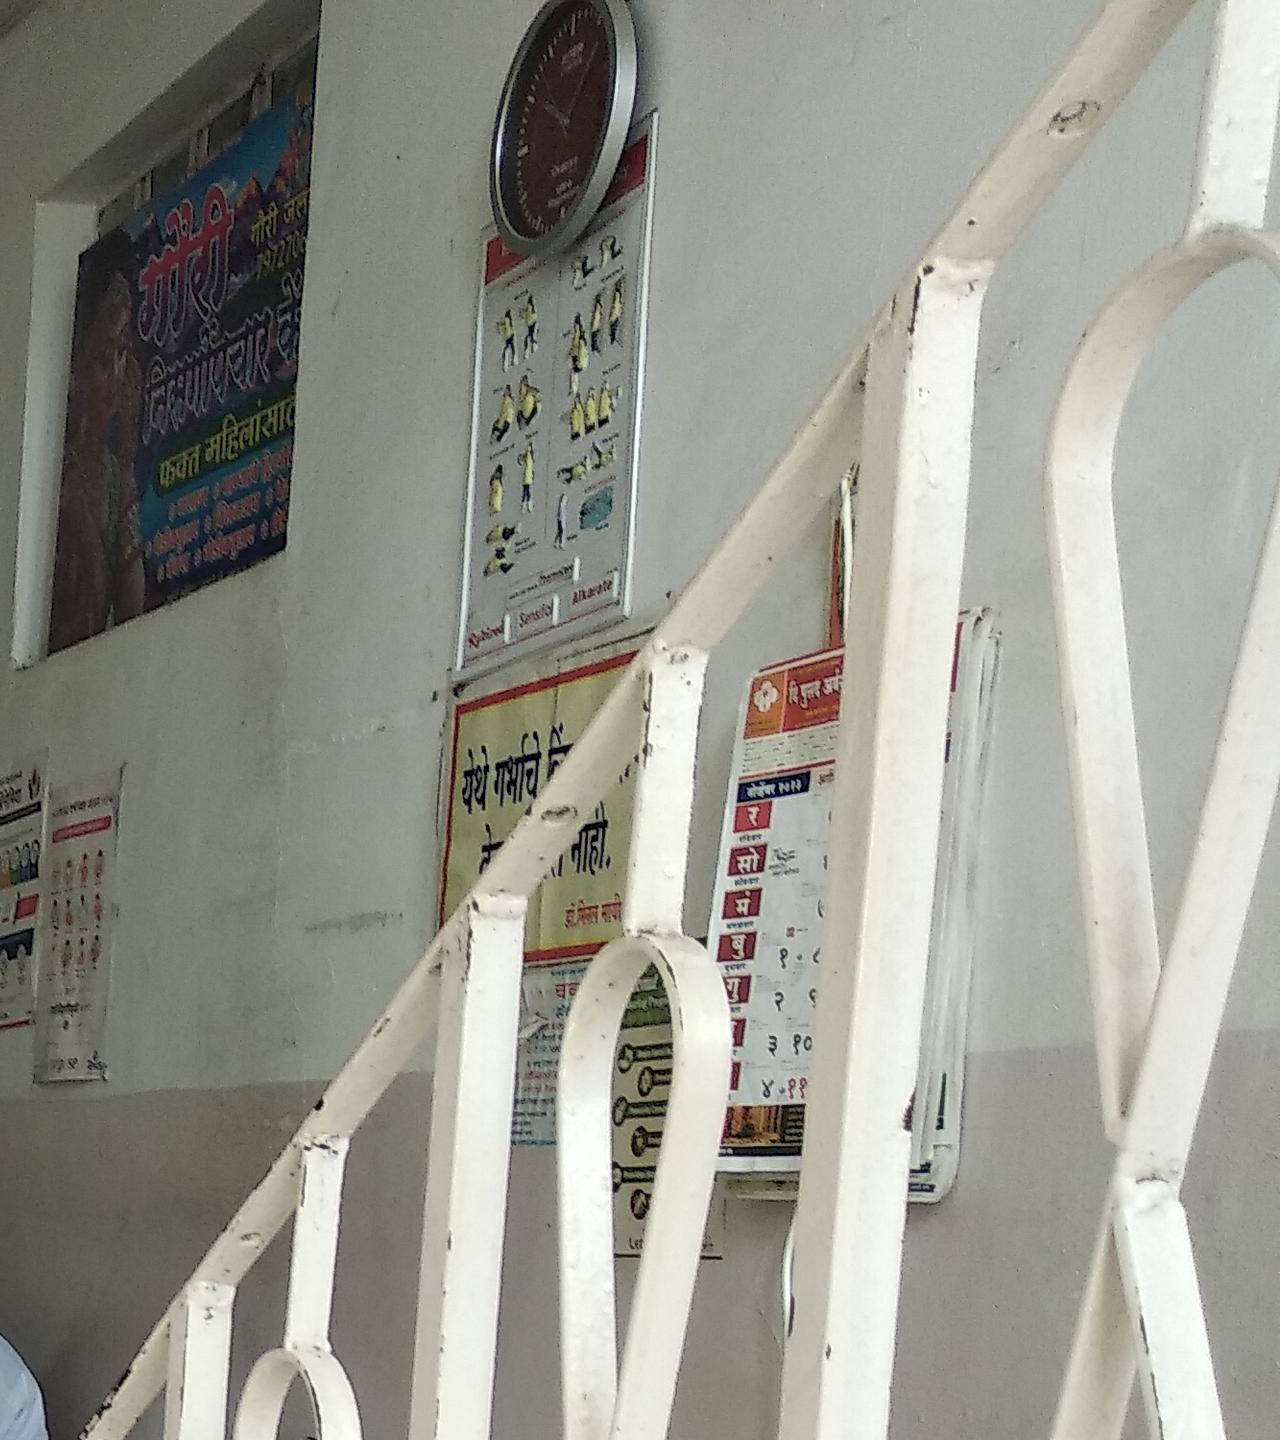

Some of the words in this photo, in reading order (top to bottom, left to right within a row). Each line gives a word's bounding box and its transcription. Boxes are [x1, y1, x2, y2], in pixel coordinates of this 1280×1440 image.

[140, 183, 234, 347] गौरी
[159, 444, 201, 488] फक्त
[462, 745, 489, 814] येथे
[494, 731, 542, 807] गर्भाचे
[747, 806, 760, 826] र
[571, 801, 611, 876] नाही.
[736, 847, 759, 874] सो
[735, 890, 751, 915] मं
[730, 934, 747, 960] बु
[780, 949, 788, 969] १
[774, 992, 784, 1011] २
[768, 1035, 777, 1056] ३
[793, 1034, 813, 1055] १०
[761, 1079, 774, 1098] ४
[788, 1078, 809, 1099] ११
